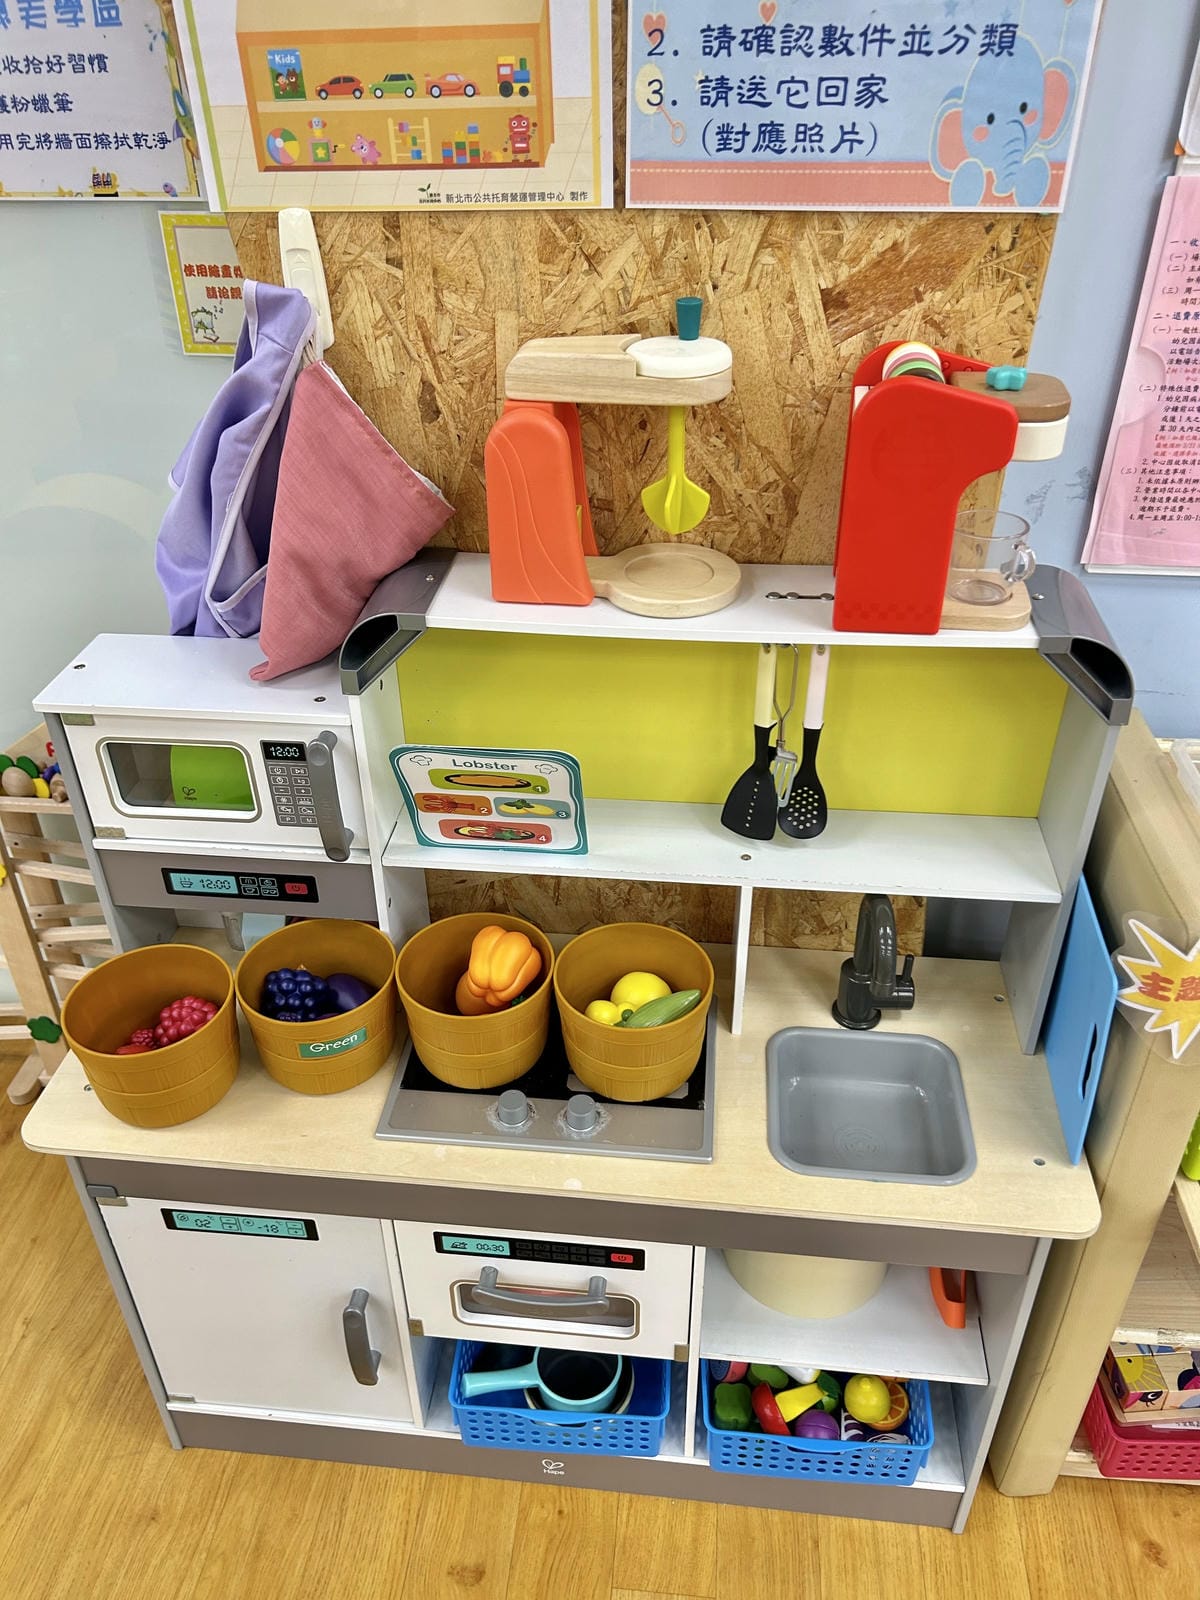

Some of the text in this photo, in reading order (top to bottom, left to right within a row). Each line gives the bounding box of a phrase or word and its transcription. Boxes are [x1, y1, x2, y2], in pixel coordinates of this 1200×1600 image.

[647, 22, 1019, 58] 2. 請確認數件並分類
[0, 53, 109, 74] 收拾好習慣
[275, 54, 296, 64] Kids
[646, 74, 889, 109] 3. 請送它回家
[702, 120, 879, 156] (對應照片)
[446, 191, 564, 204] 新北市公共托育營運管理中心
[570, 191, 588, 202] 製作
[270, 746, 299, 757] 12:00
[452, 758, 518, 771] Lobster
[199, 879, 231, 890] 12:00
[310, 1034, 358, 1053] Green
